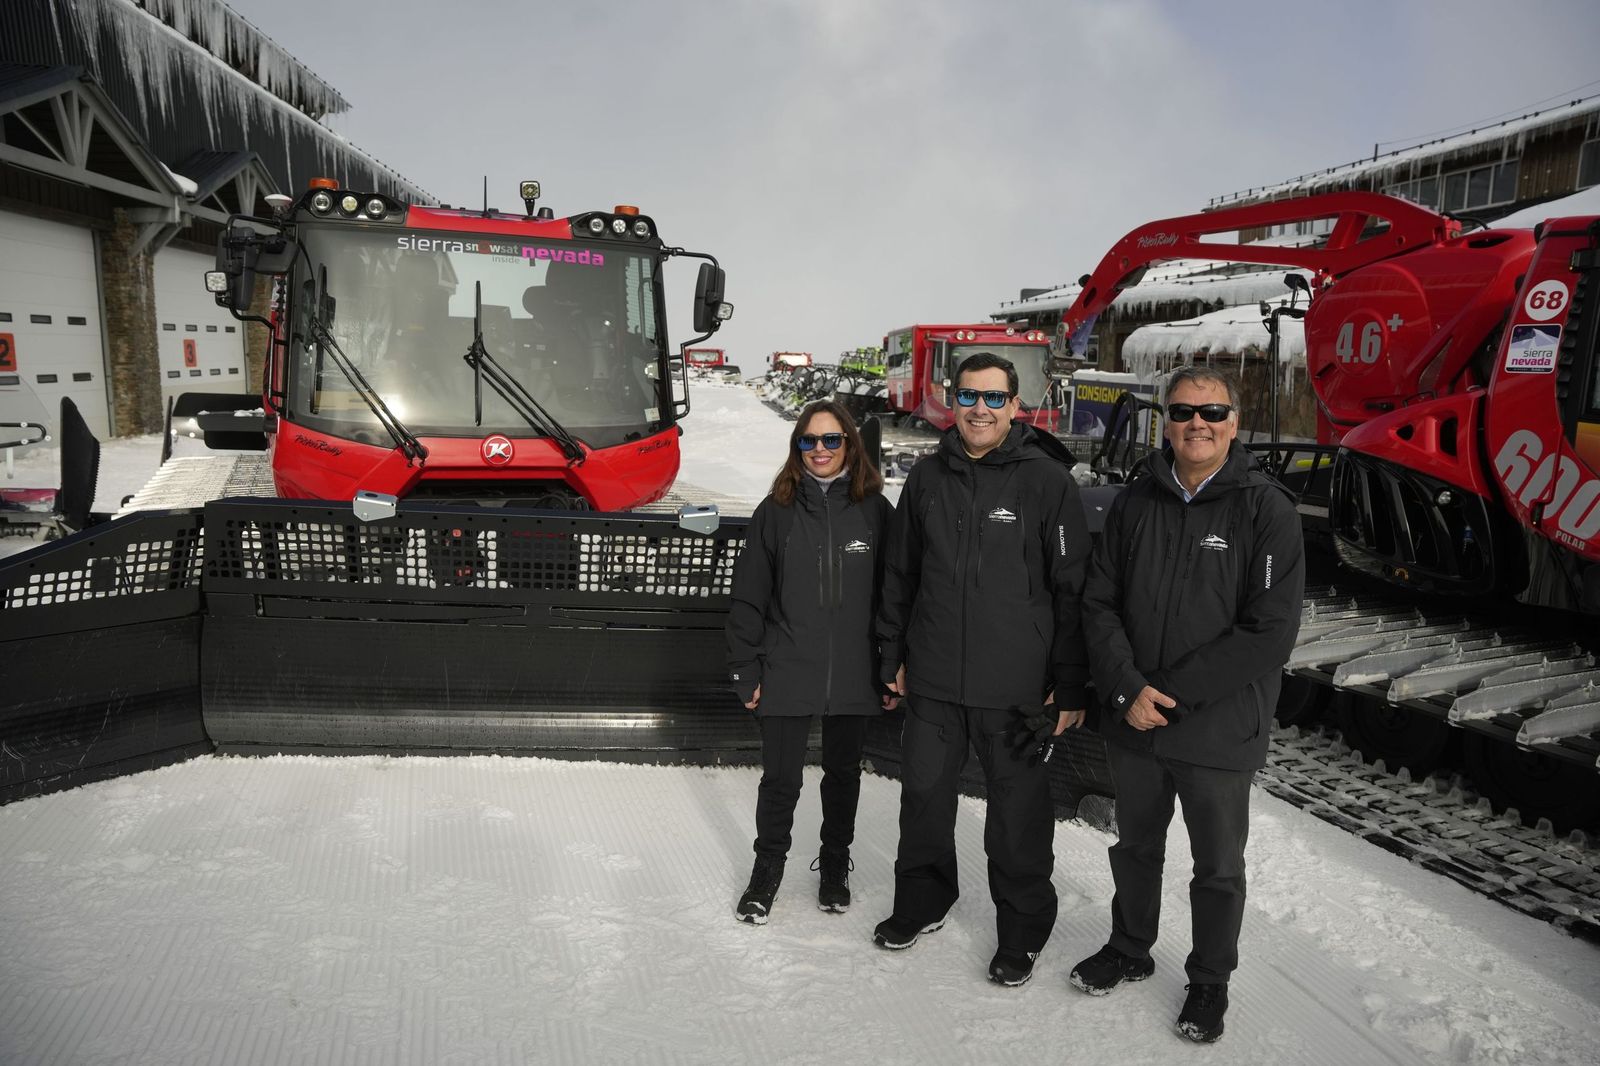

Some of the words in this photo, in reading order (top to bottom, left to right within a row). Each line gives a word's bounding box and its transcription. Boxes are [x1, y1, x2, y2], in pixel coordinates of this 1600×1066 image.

[397, 234, 464, 253] sierra
[521, 245, 605, 266] nevada
[1529, 290, 1564, 310] 68
[185, 343, 194, 364] 3
[1511, 357, 1552, 366] nevada
[1523, 348, 1553, 358] sierra
[1077, 384, 1127, 404] CONSIGNA
[1494, 429, 1600, 540] 600
[1555, 530, 1585, 551] POLAR
